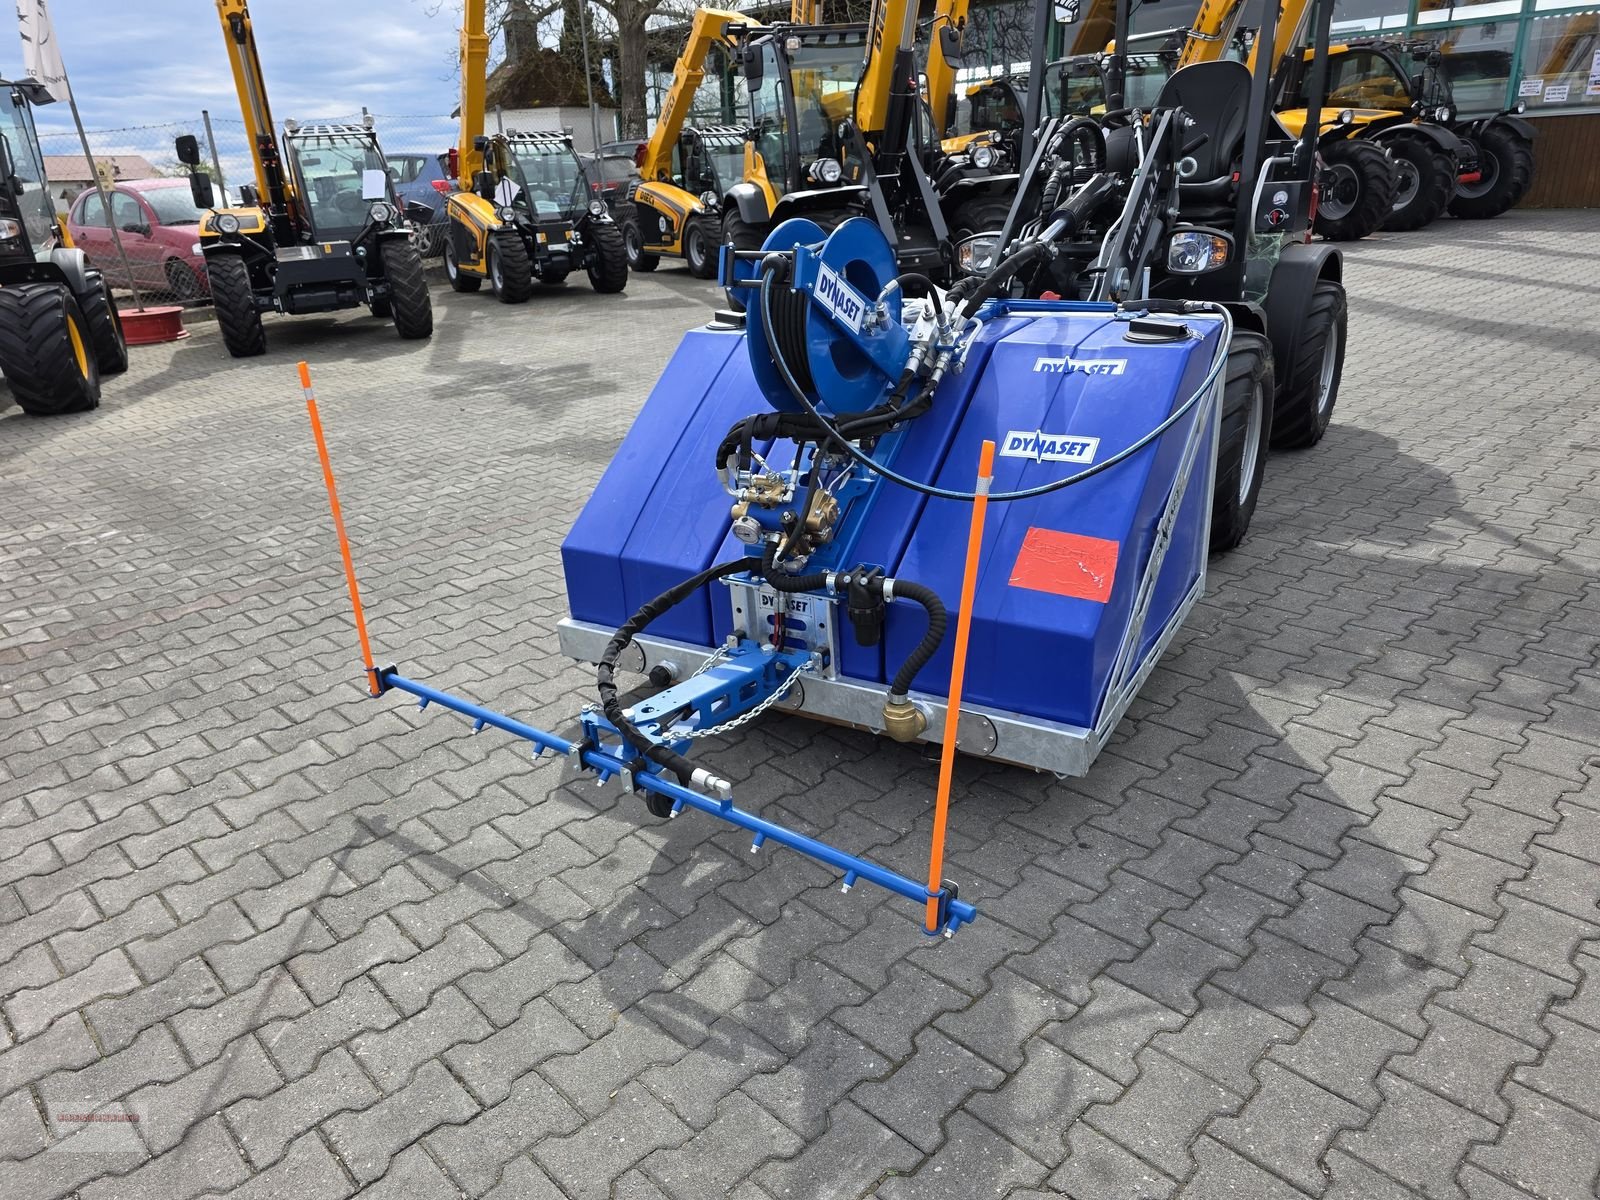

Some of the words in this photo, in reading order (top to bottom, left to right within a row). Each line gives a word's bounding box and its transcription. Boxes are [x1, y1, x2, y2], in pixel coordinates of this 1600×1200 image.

[639, 190, 655, 206] DIECI
[1128, 169, 1161, 261] PITBULL
[820, 273, 860, 322] DYNASET
[1008, 434, 1090, 459] DYNASET
[761, 594, 808, 612] DYASET
